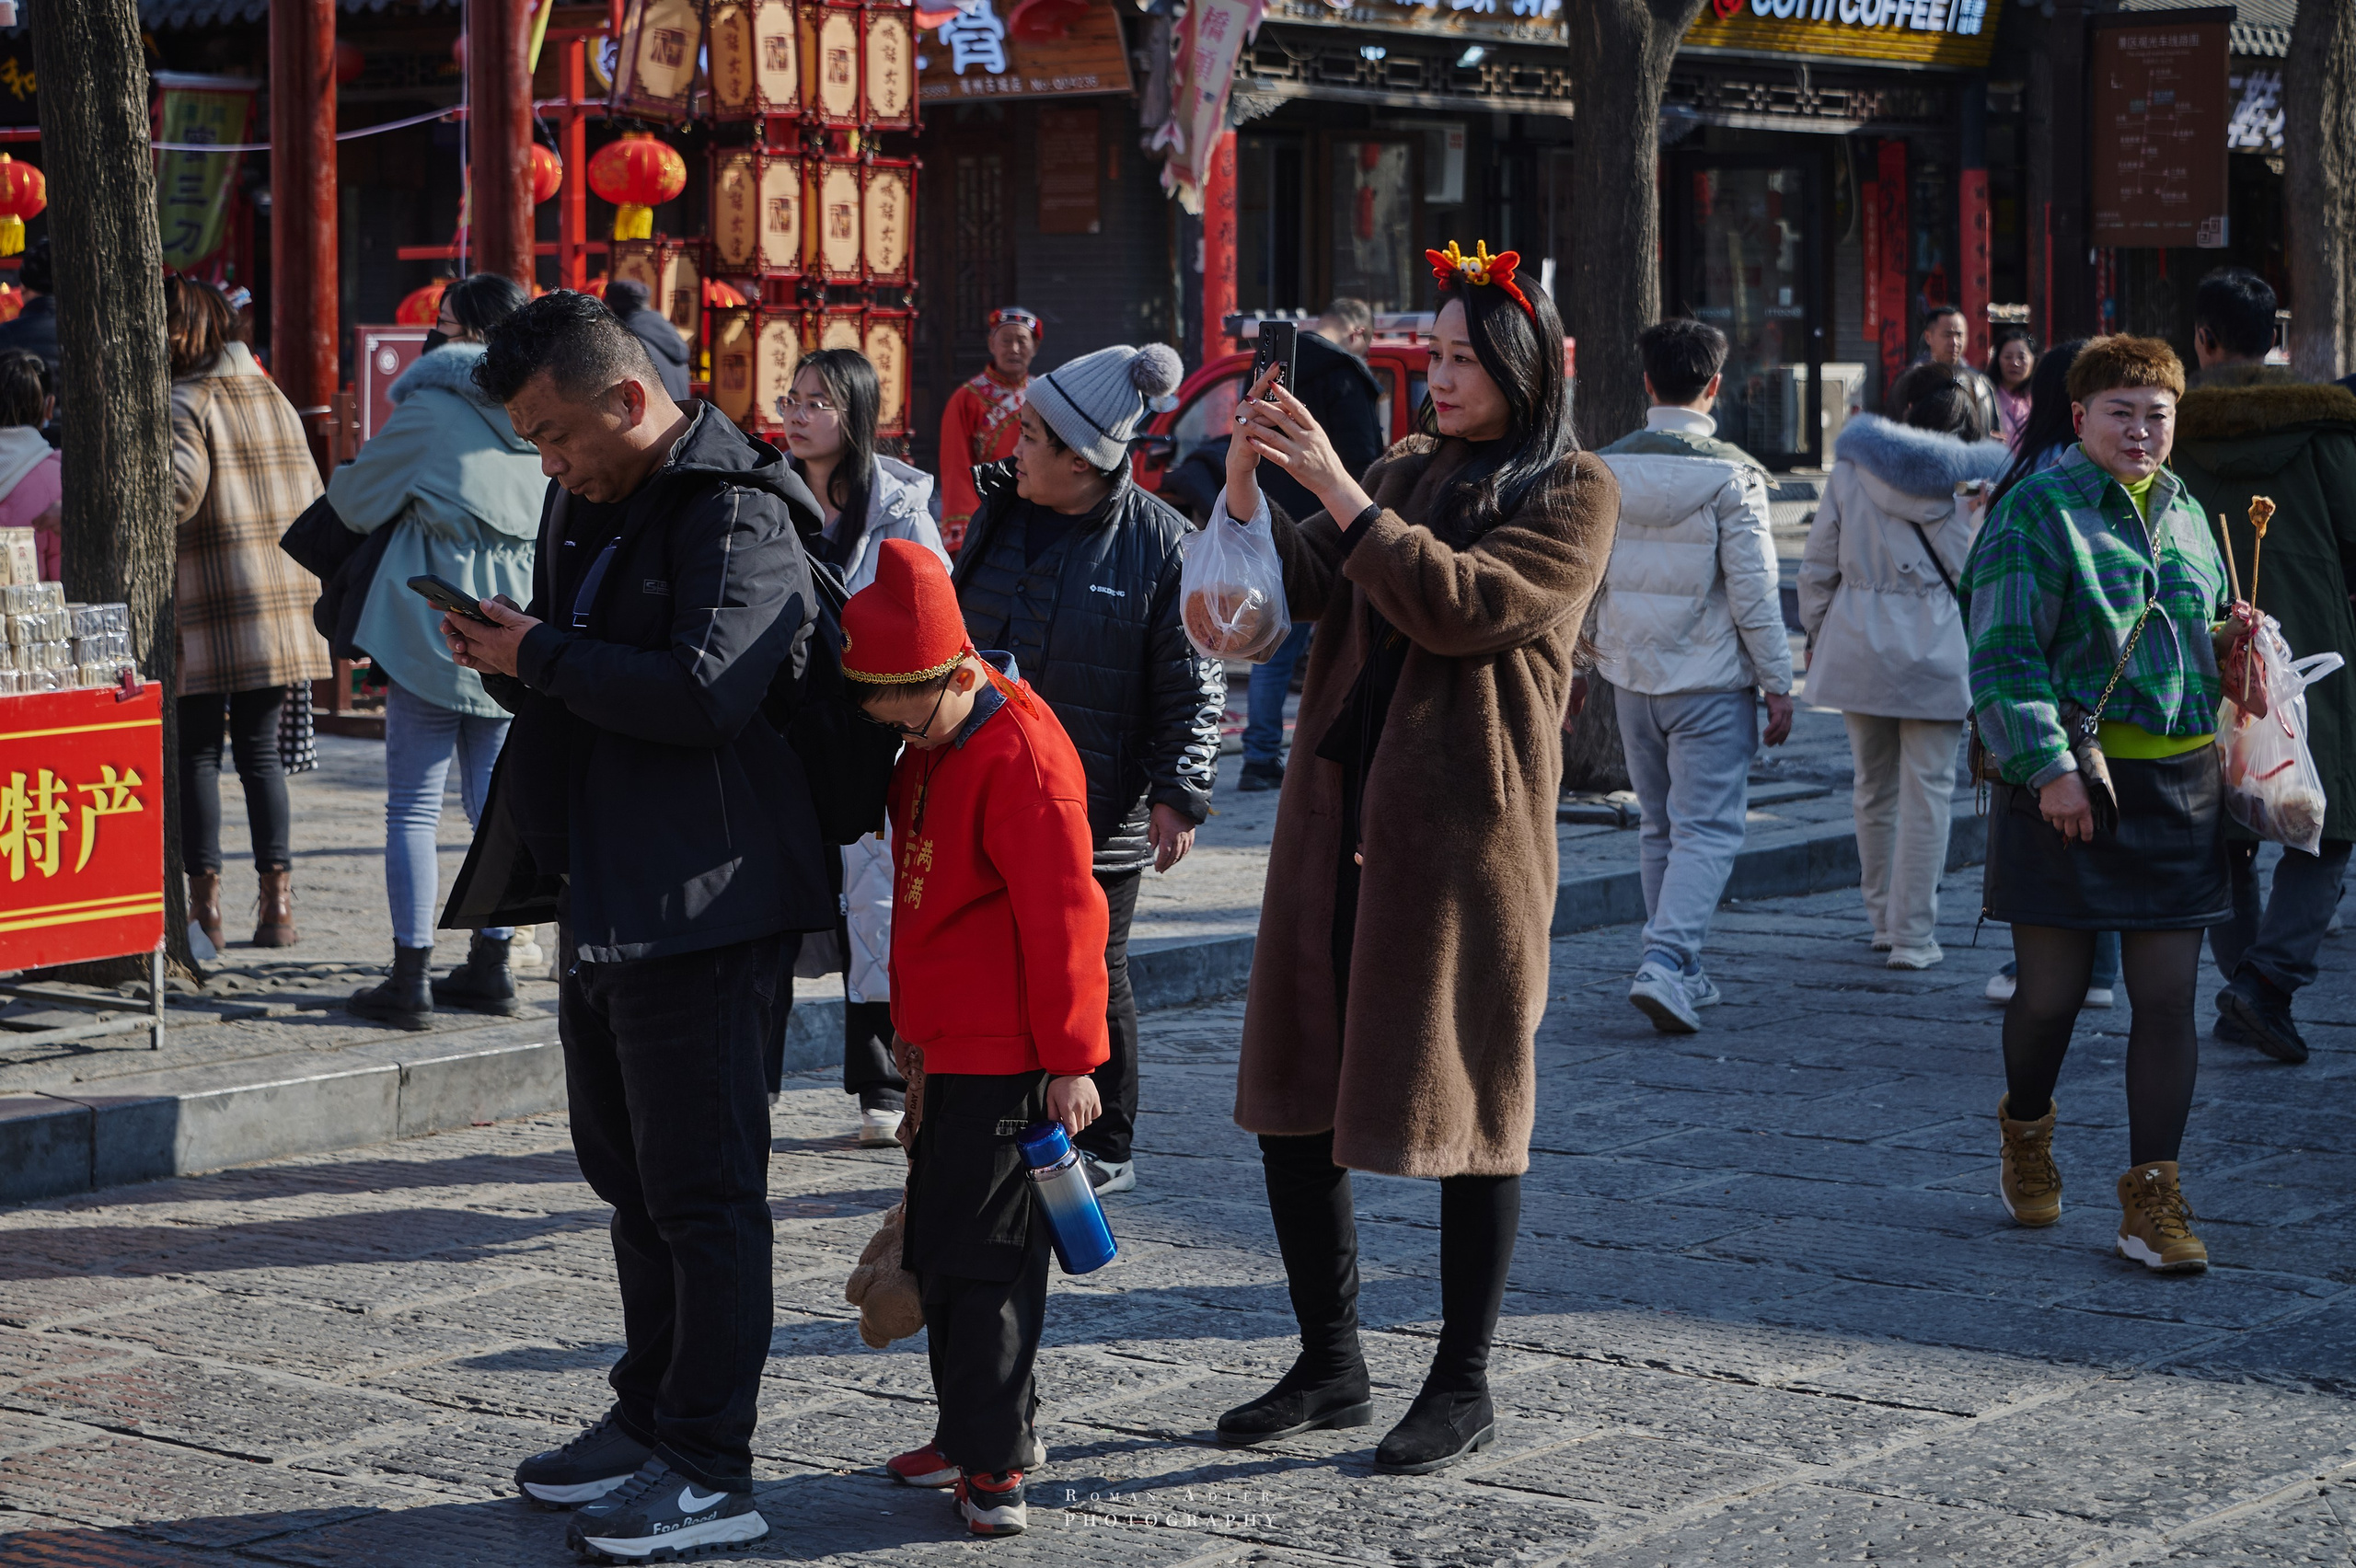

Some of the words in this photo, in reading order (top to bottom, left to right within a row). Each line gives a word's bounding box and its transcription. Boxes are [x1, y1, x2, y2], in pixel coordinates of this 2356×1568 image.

[1839, 0, 1947, 31] COFFEE
[0, 765, 144, 883] 特产
[909, 1093, 918, 1110] DAY
